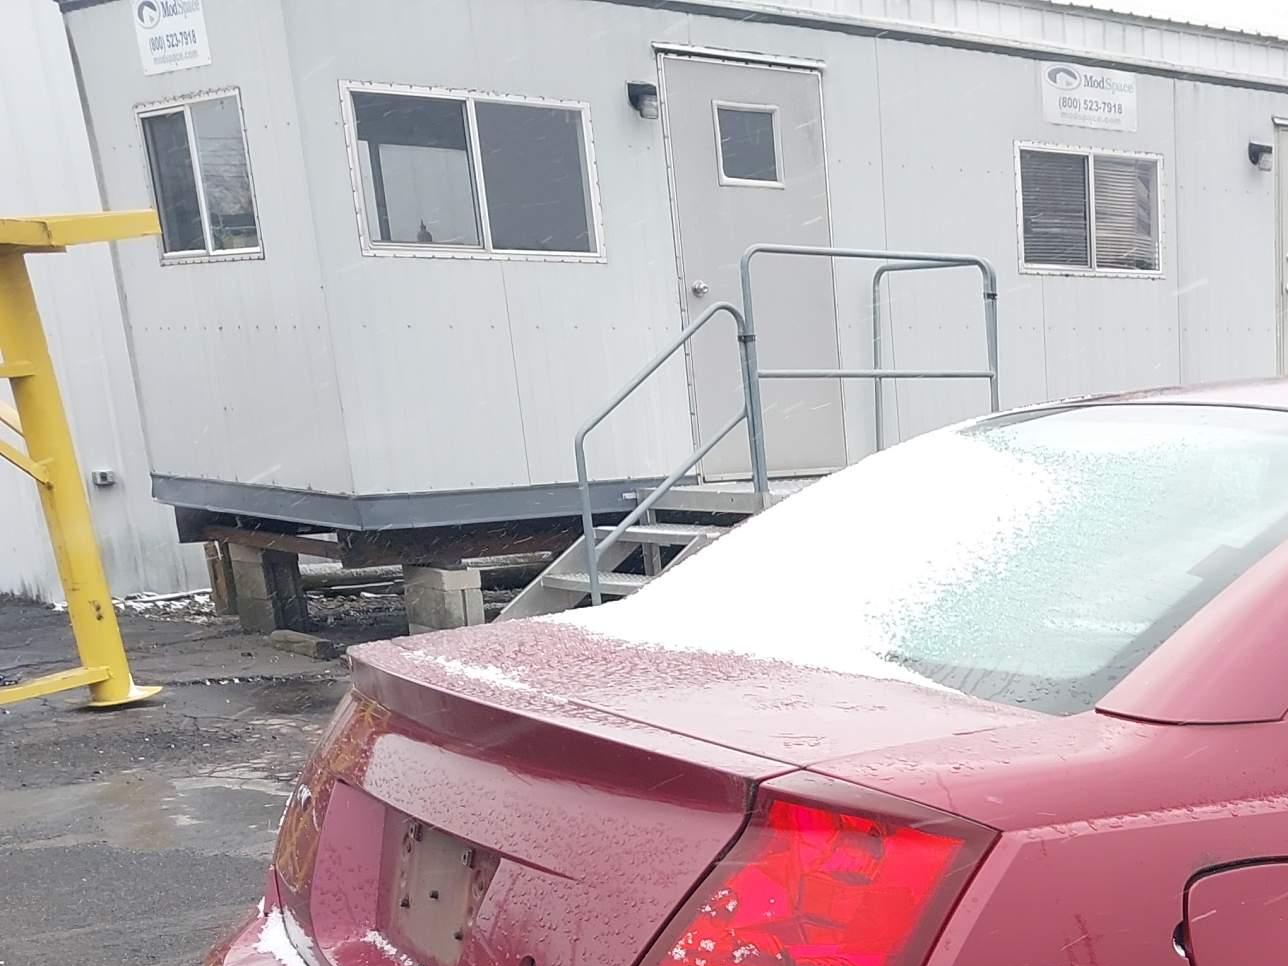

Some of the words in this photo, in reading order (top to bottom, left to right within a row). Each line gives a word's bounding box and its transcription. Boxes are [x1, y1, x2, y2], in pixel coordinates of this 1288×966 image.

[165, 29, 197, 49] 523-7918
[1083, 74, 1135, 95] ModSpace
[1059, 96, 1081, 112] (800)
[1083, 99, 1123, 115] 523-7918
